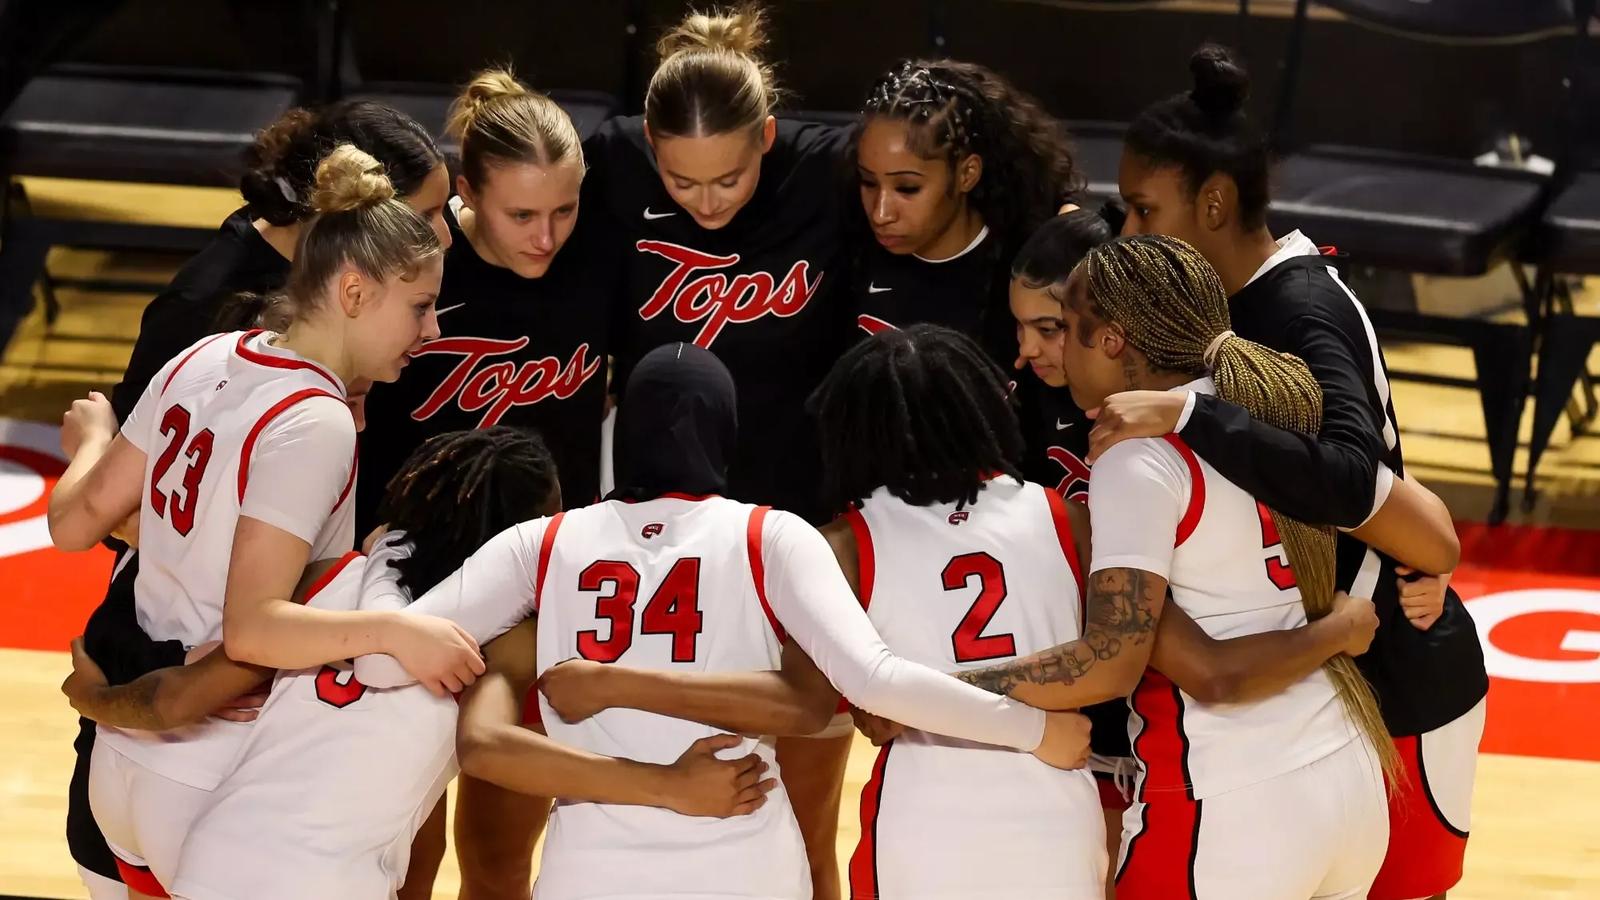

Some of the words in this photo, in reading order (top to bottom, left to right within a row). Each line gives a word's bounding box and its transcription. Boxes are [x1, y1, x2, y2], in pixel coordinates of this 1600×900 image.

[636, 239, 824, 350] Tops
[410, 336, 601, 430] Tops
[150, 403, 215, 537] 23
[576, 556, 703, 663] 34
[941, 550, 1017, 663] 2
